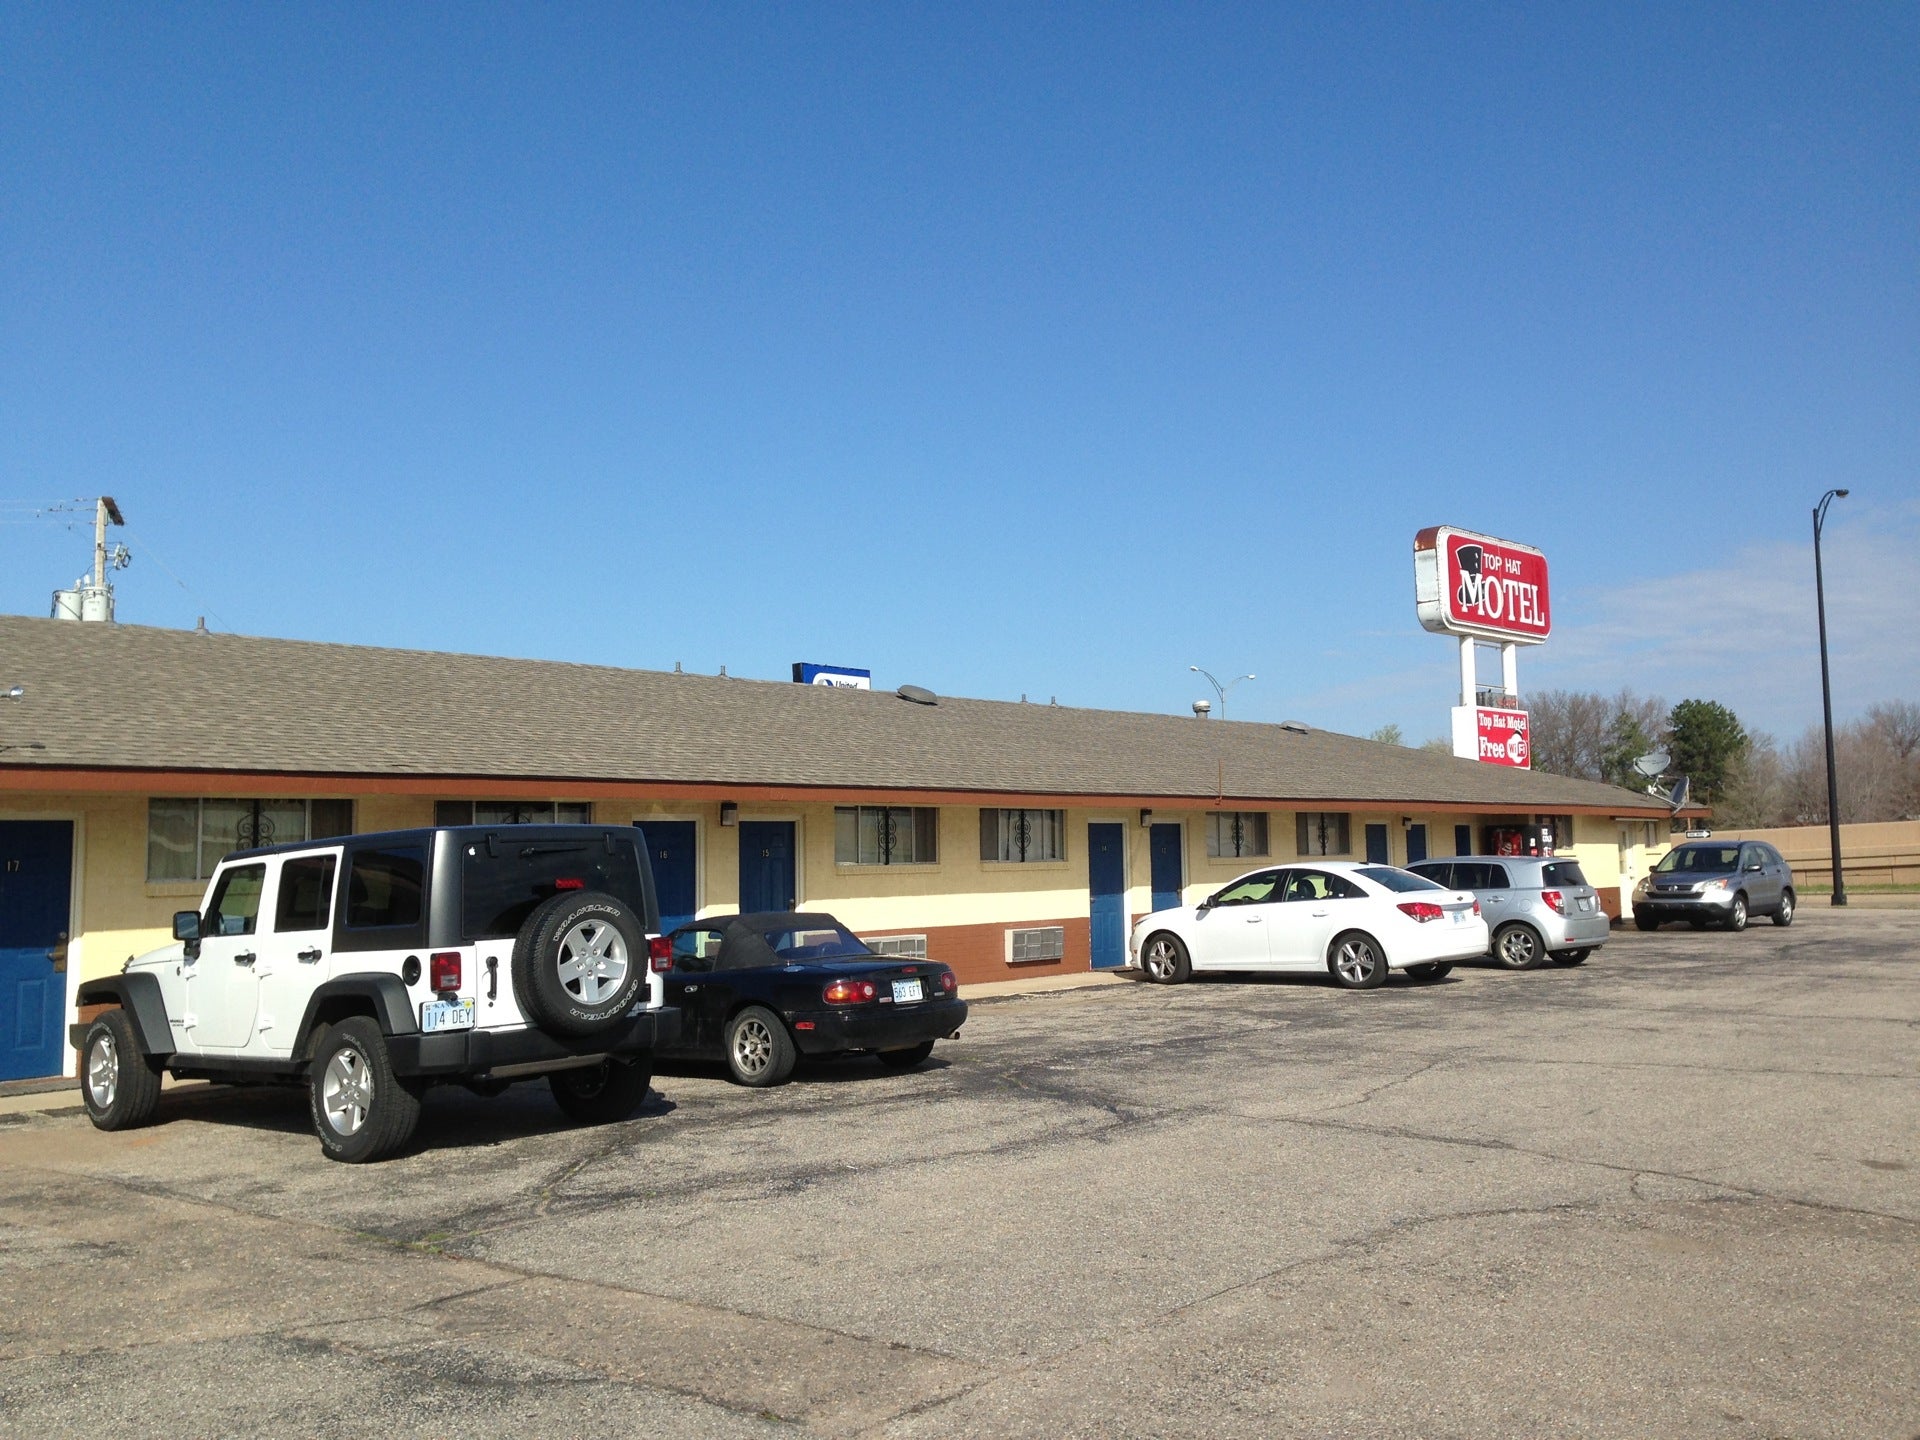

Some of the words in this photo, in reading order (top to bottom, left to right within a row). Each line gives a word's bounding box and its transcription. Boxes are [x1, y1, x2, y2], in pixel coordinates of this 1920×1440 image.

[1483, 553, 1502, 571] TOP
[1505, 558, 1521, 576] HAT
[1460, 569, 1545, 627] MOTEL
[1479, 713, 1492, 730] Top
[1493, 714, 1506, 728] Hat
[1507, 715, 1527, 730] Motel
[1479, 736, 1505, 759] Free
[7, 860, 20, 872] 17
[553, 904, 621, 941] WRANGLER
[427, 1011, 445, 1028] 114
[452, 1009, 471, 1024] DEY
